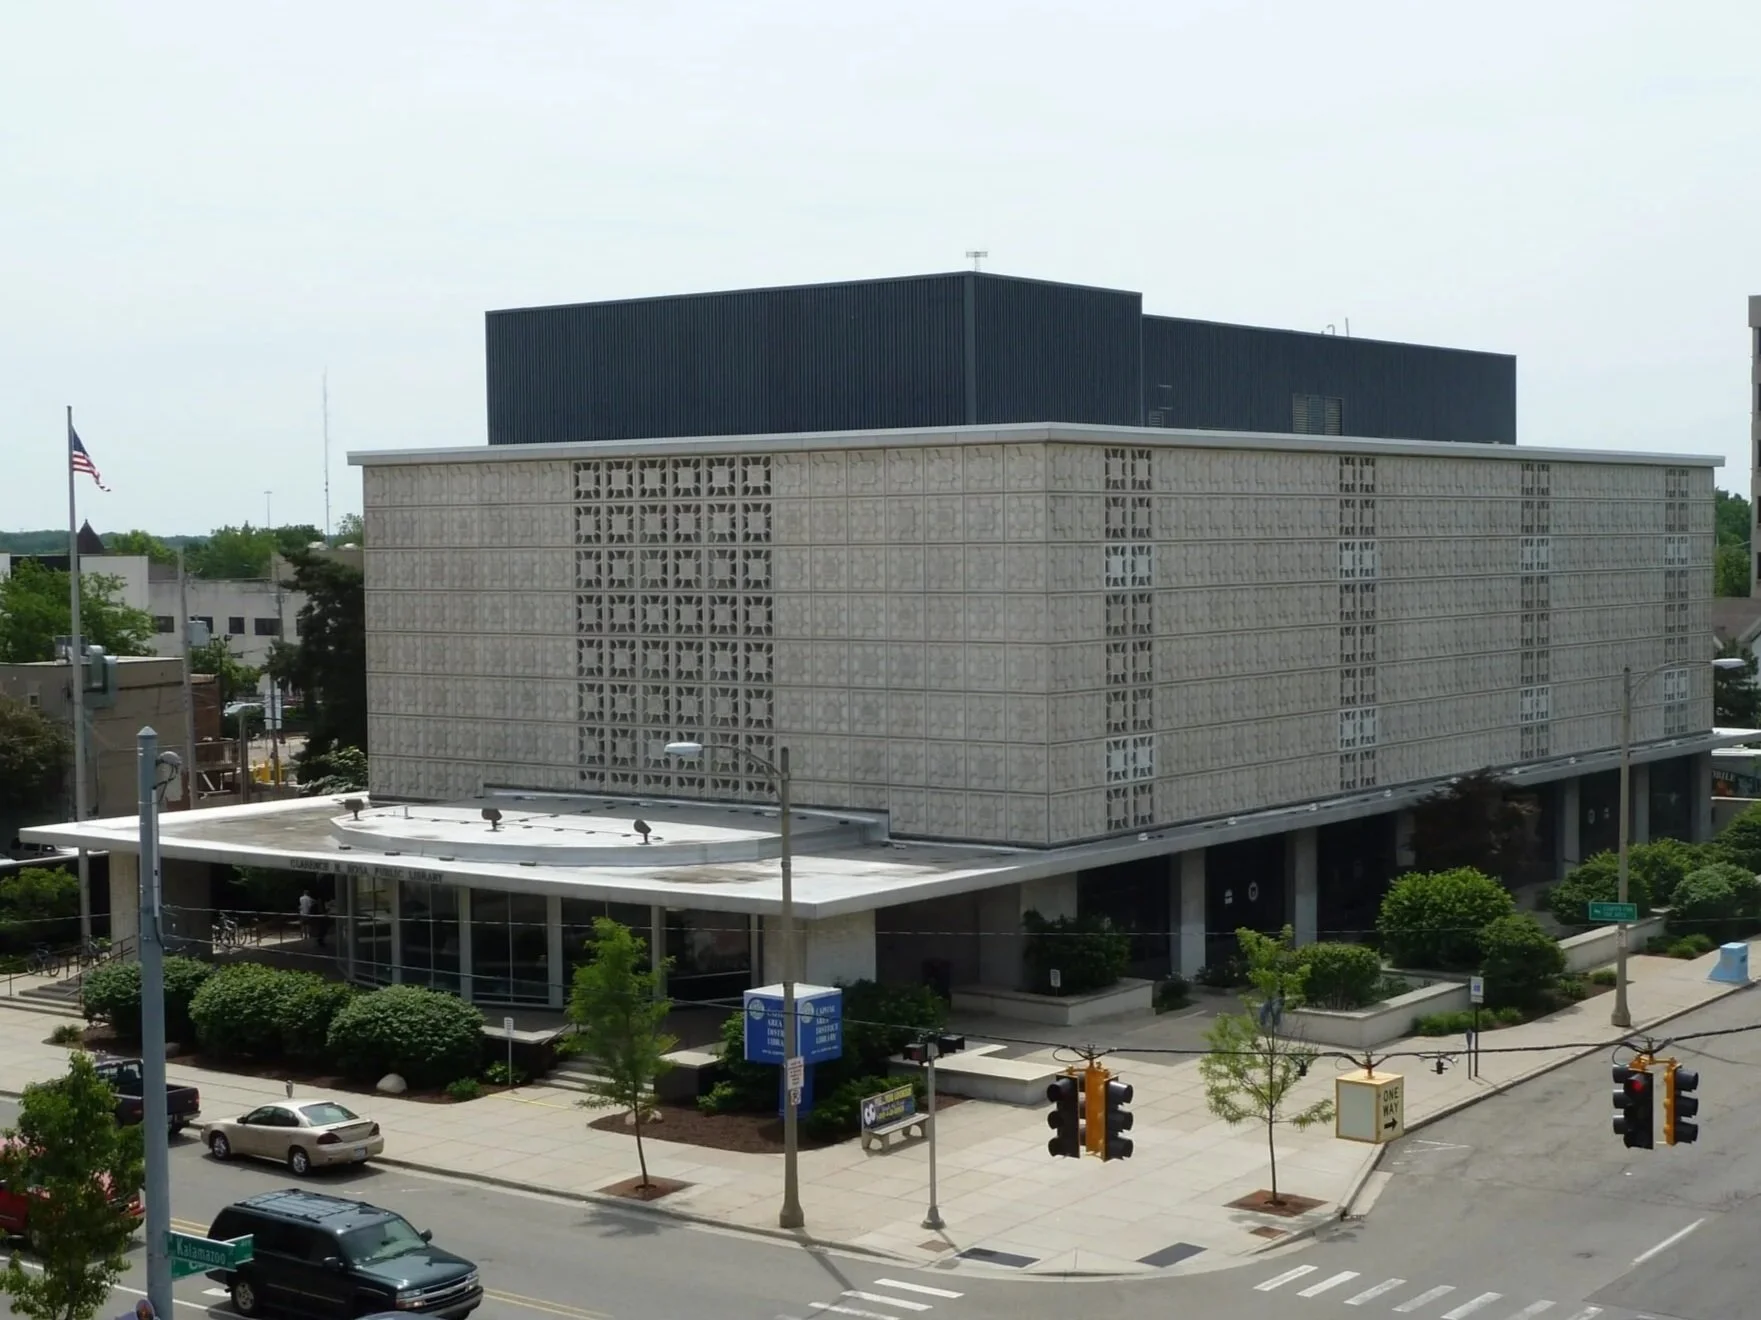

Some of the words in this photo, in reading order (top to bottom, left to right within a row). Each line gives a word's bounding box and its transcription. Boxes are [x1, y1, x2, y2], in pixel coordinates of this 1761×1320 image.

[408, 869, 444, 883] LIBRARY
[1383, 1086, 1400, 1102] ONE
[1383, 1101, 1400, 1117] WAY
[176, 1237, 226, 1265] Kalamazoo
